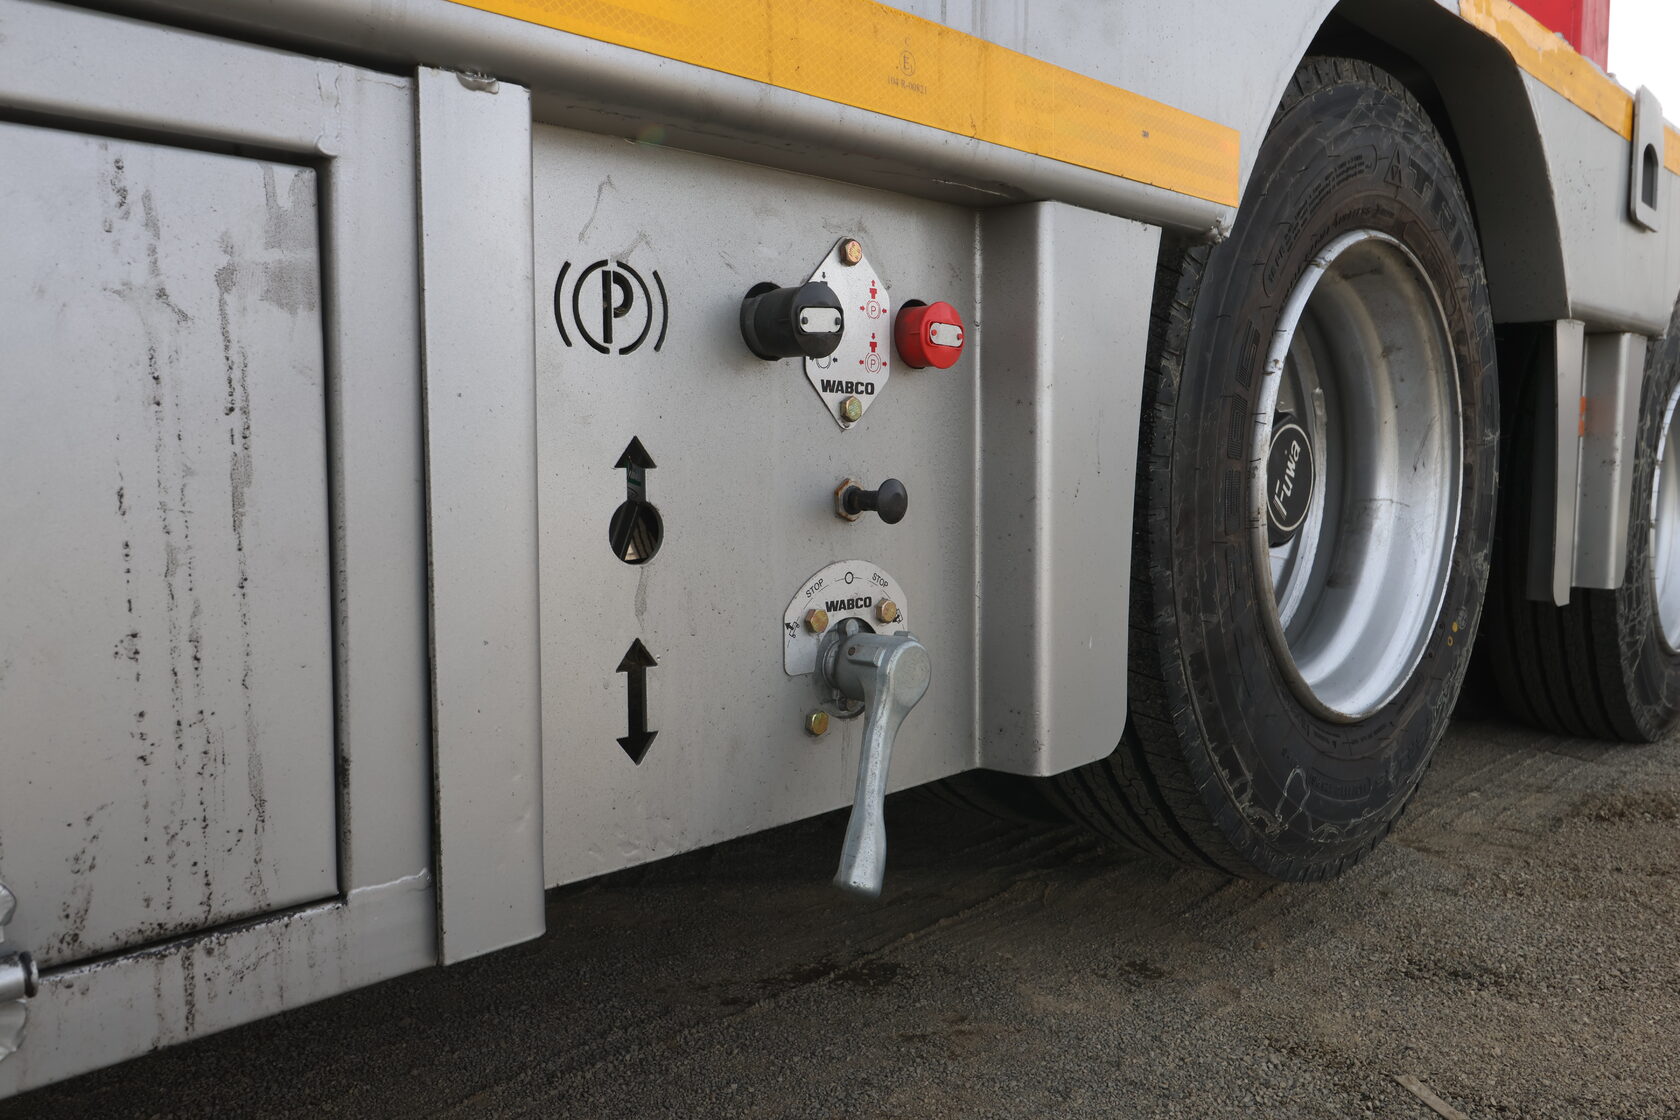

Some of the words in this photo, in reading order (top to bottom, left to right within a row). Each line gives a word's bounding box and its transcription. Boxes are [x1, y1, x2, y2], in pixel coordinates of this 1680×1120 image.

[820, 379, 875, 396] WABCO
[1273, 440, 1301, 520] Fuwa
[805, 578, 824, 598] STOP
[872, 573, 889, 588] STOP
[825, 596, 873, 612] WABCO
